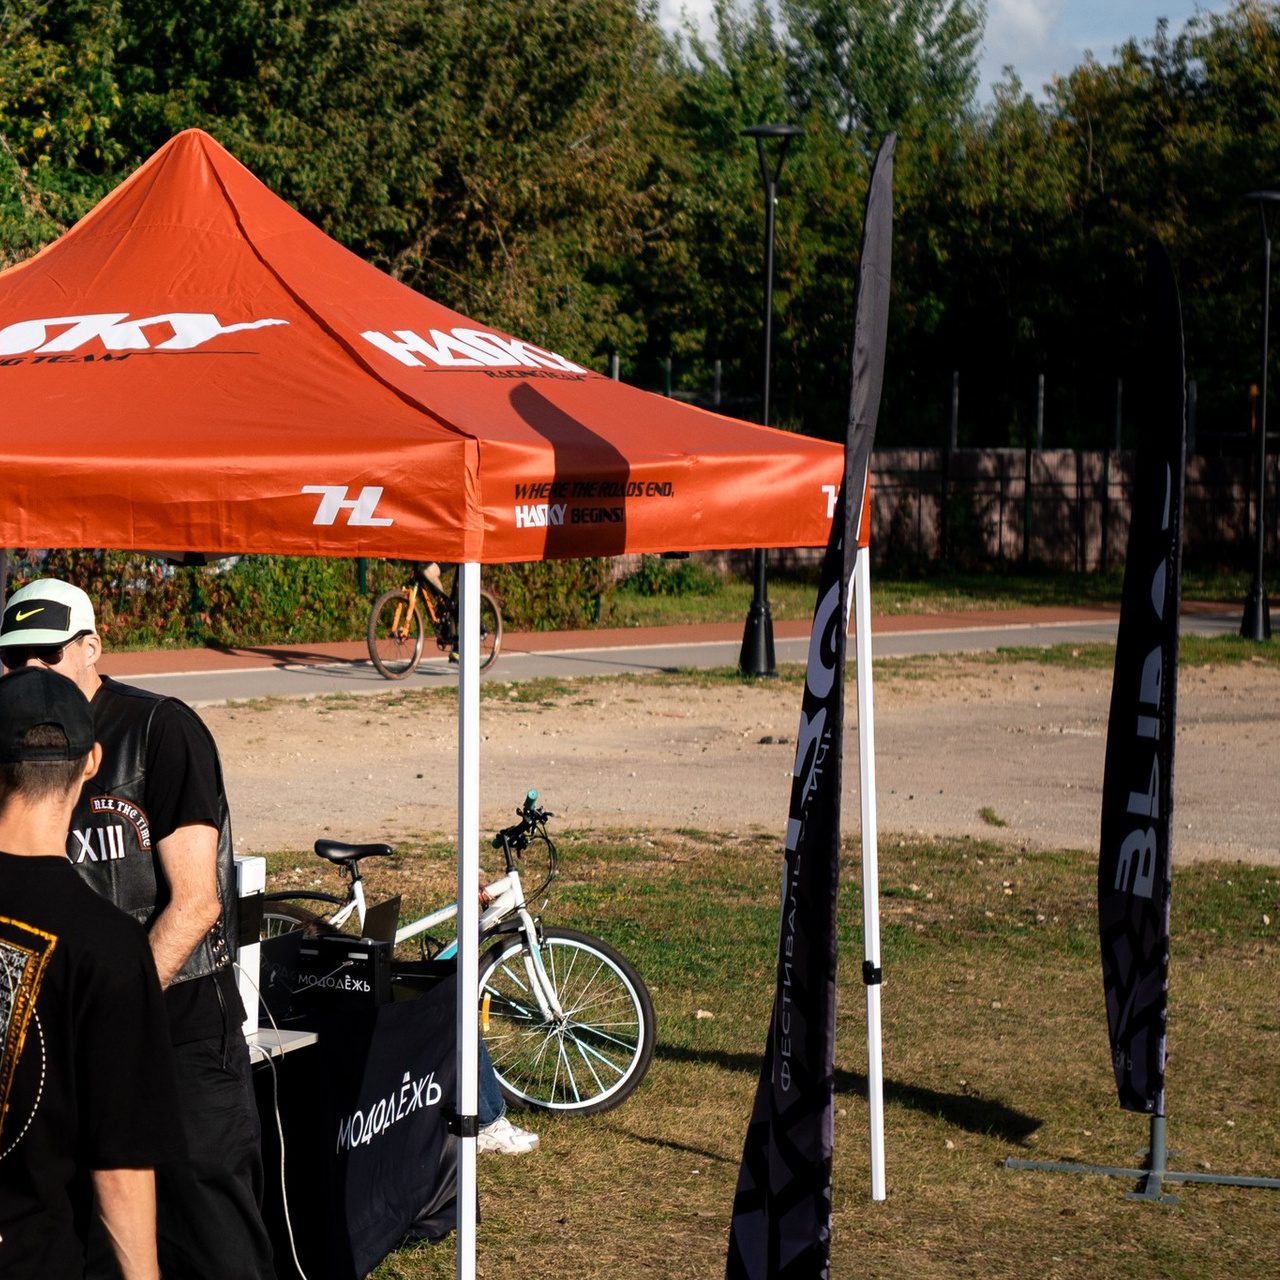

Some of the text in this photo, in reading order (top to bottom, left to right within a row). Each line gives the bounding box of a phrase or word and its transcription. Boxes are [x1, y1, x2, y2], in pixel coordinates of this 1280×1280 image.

[35, 352, 134, 365] TEAM
[359, 328, 588, 374] HASKY
[483, 370, 542, 379] RACING
[514, 481, 675, 500] WHERE THE ROADS END,
[515, 503, 624, 529] HASKY BEGINS!
[117, 800, 138, 819] THE
[135, 816, 151, 847] TIME
